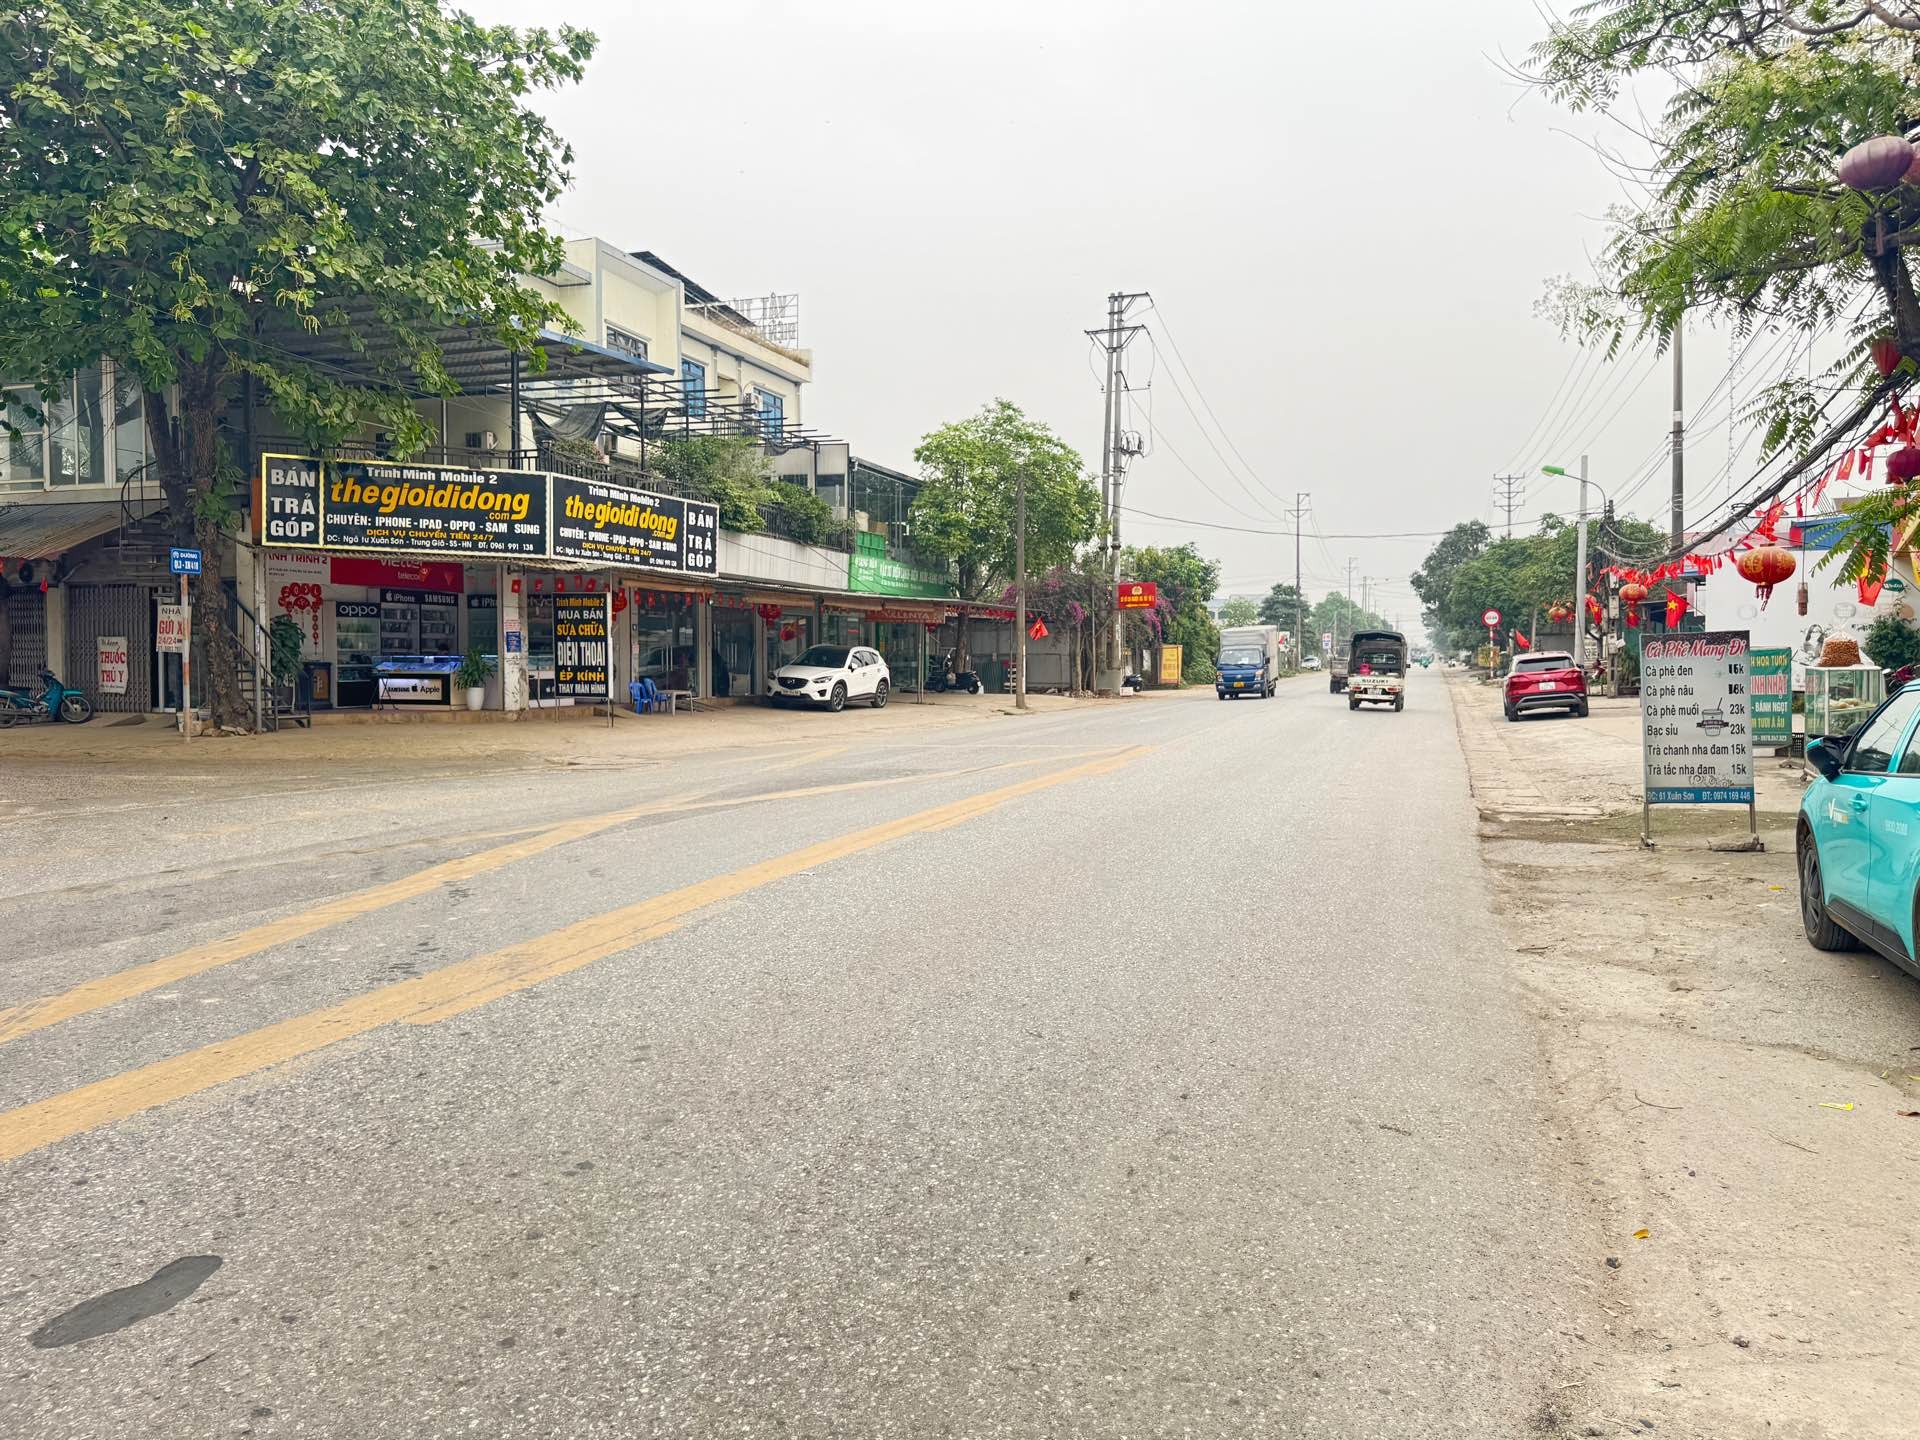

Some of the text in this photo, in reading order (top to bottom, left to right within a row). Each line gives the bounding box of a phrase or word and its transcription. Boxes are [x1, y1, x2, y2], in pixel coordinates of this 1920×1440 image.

[270, 467, 316, 487] BÁN
[402, 470, 436, 480] Minh
[440, 472, 484, 484] Mobile
[489, 474, 498, 484] 2
[270, 492, 316, 515] TRẢ
[331, 478, 530, 520] thegioididong
[610, 489, 629, 502] Minh
[654, 498, 660, 508] 2
[326, 512, 540, 535] CHUYÊN: IPHONE IPAD OPPO SAM SUNG
[565, 494, 678, 540] thegioididong
[688, 510, 714, 528] BÁN
[270, 516, 315, 538] GÓP
[366, 529, 389, 538] DỊCH
[392, 530, 406, 538] VỤ
[472, 532, 494, 542] 24/7
[370, 536, 390, 544] Xuân
[411, 538, 430, 548] Trung
[612, 534, 626, 545] IPAD
[630, 536, 644, 548] OPPO
[648, 539, 662, 550] SAM
[688, 532, 712, 551] TRẢ
[688, 551, 713, 568] GÓP
[394, 594, 455, 604] iPhone SAMSUNG
[600, 598, 604, 606] 2
[339, 604, 378, 616] oppo
[558, 608, 604, 620] MUA BÁN
[556, 620, 605, 636] SỬA CHỮA
[100, 646, 126, 664] THUỐC
[558, 636, 578, 671] ĐIỆN
[580, 642, 606, 671] THOẠI
[1645, 638, 1747, 662] Cà Phê Mang Đi
[118, 670, 124, 682] Y
[577, 670, 605, 682] KÍNH
[1645, 666, 1657, 677] Cà
[1659, 664, 1675, 680] phê
[1677, 664, 1693, 676] đen
[420, 686, 440, 694] Apple
[558, 683, 574, 694] THAY
[1646, 686, 1658, 696] Cà
[1660, 684, 1676, 700] phê
[1678, 684, 1694, 696] nâu
[1750, 674, 1766, 696] INH
[1766, 670, 1788, 700] NHẬT
[1646, 702, 1745, 719] Cà phê muối 23k
[1755, 700, 1788, 714] BÁNH NGỌT
[1646, 725, 1664, 738] Bạc
[1730, 724, 1746, 735] 23k
[1648, 744, 1746, 756] Trà chanh nha đam 15k
[1648, 762, 1746, 776] Trà tắc nha đam 15k
